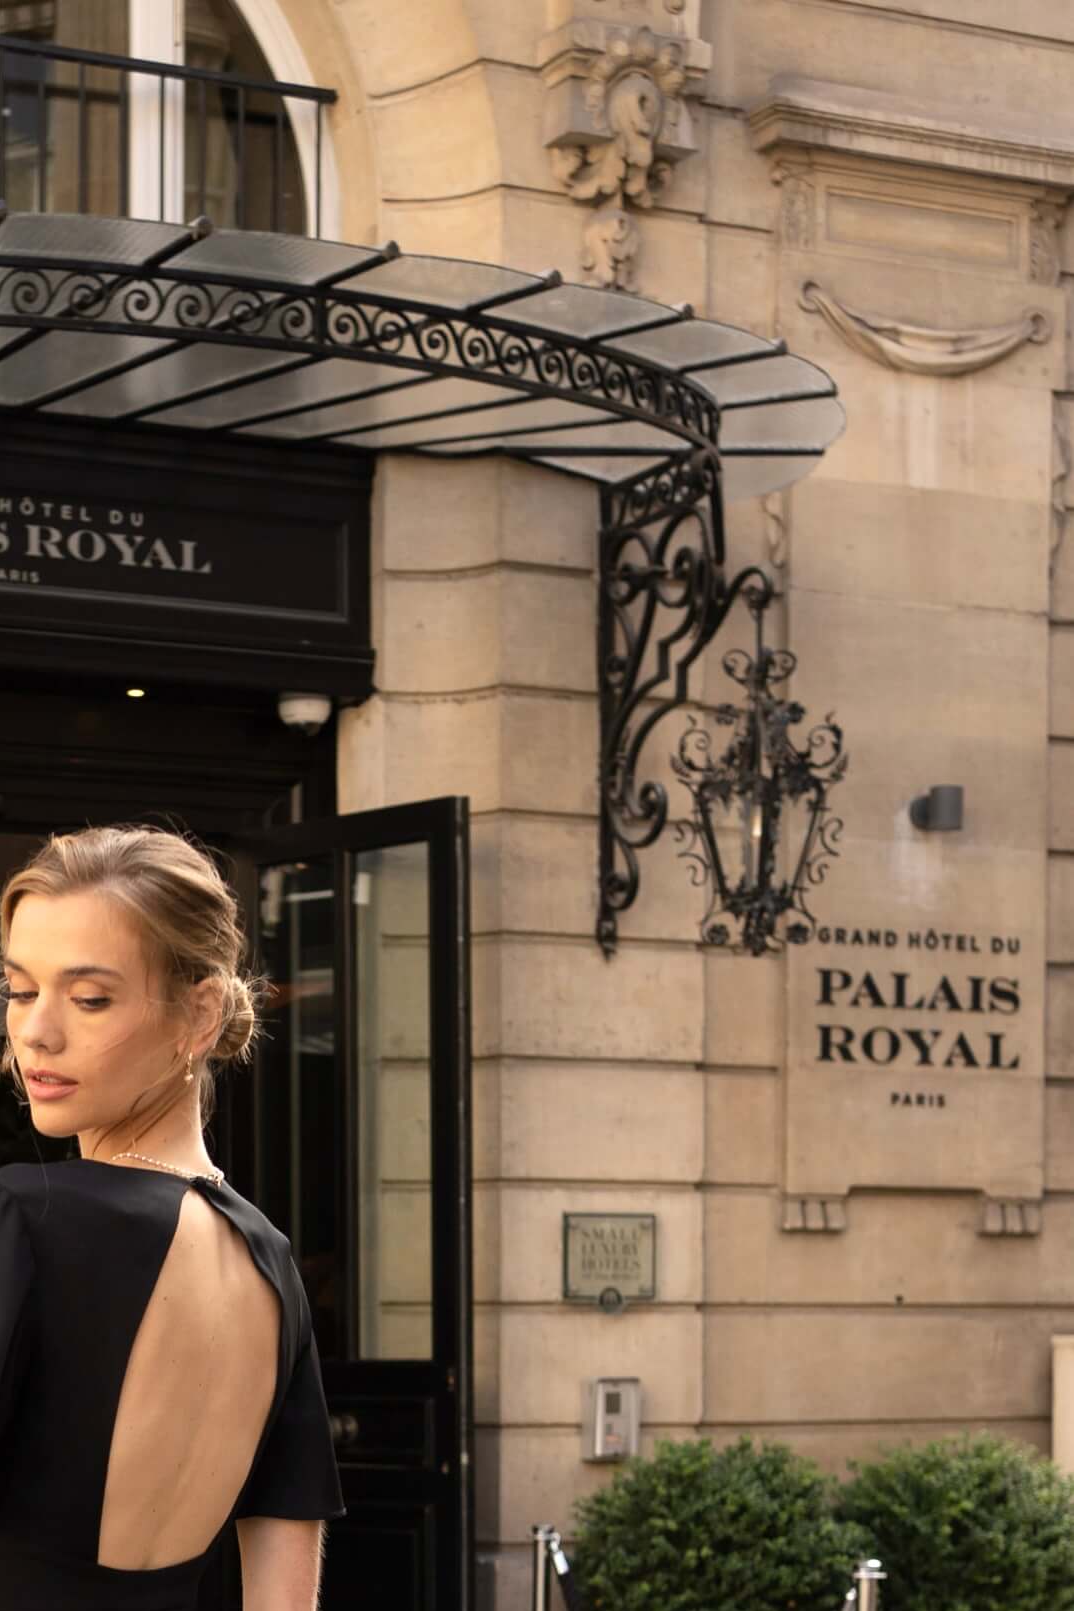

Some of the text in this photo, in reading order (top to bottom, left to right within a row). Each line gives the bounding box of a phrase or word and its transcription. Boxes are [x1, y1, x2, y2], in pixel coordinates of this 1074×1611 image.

[110, 509, 145, 528] DU
[25, 523, 212, 574] ROYAL
[818, 927, 1020, 954] GRAND HÔTEL DU
[817, 968, 1020, 1015] PALAIS
[817, 1024, 1020, 1070] ROYAL
[890, 1092, 946, 1108] PARIS
